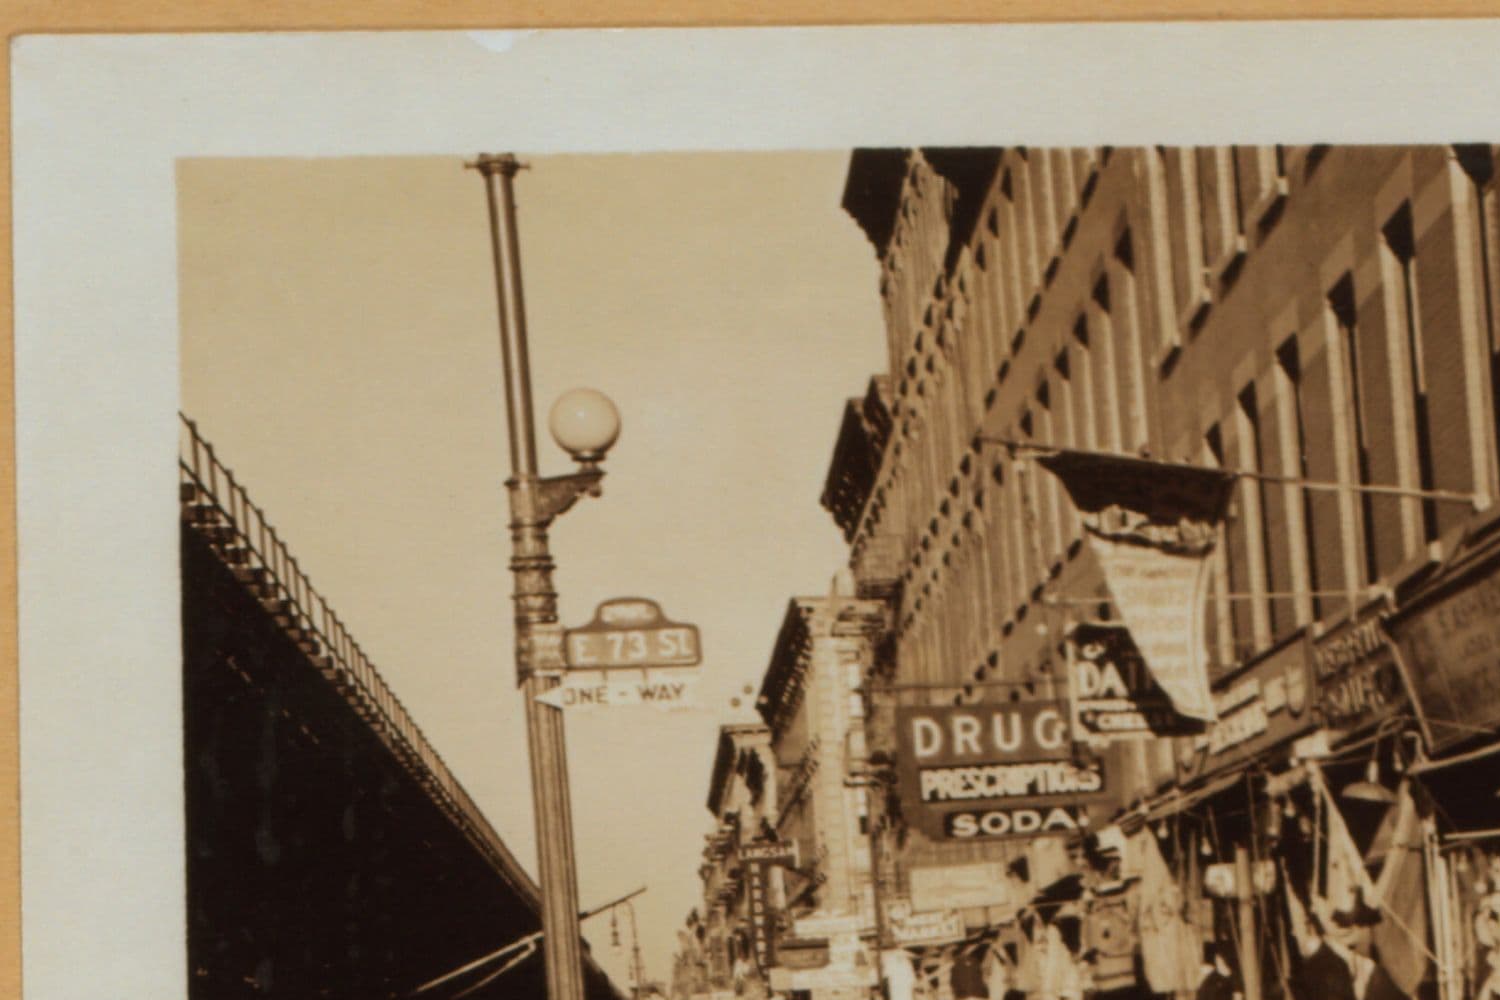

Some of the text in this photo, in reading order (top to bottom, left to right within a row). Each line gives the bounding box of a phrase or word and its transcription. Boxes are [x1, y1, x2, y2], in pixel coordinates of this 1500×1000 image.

[607, 632, 648, 662] 73
[564, 686, 608, 706] ONE
[638, 682, 685, 702] WAY
